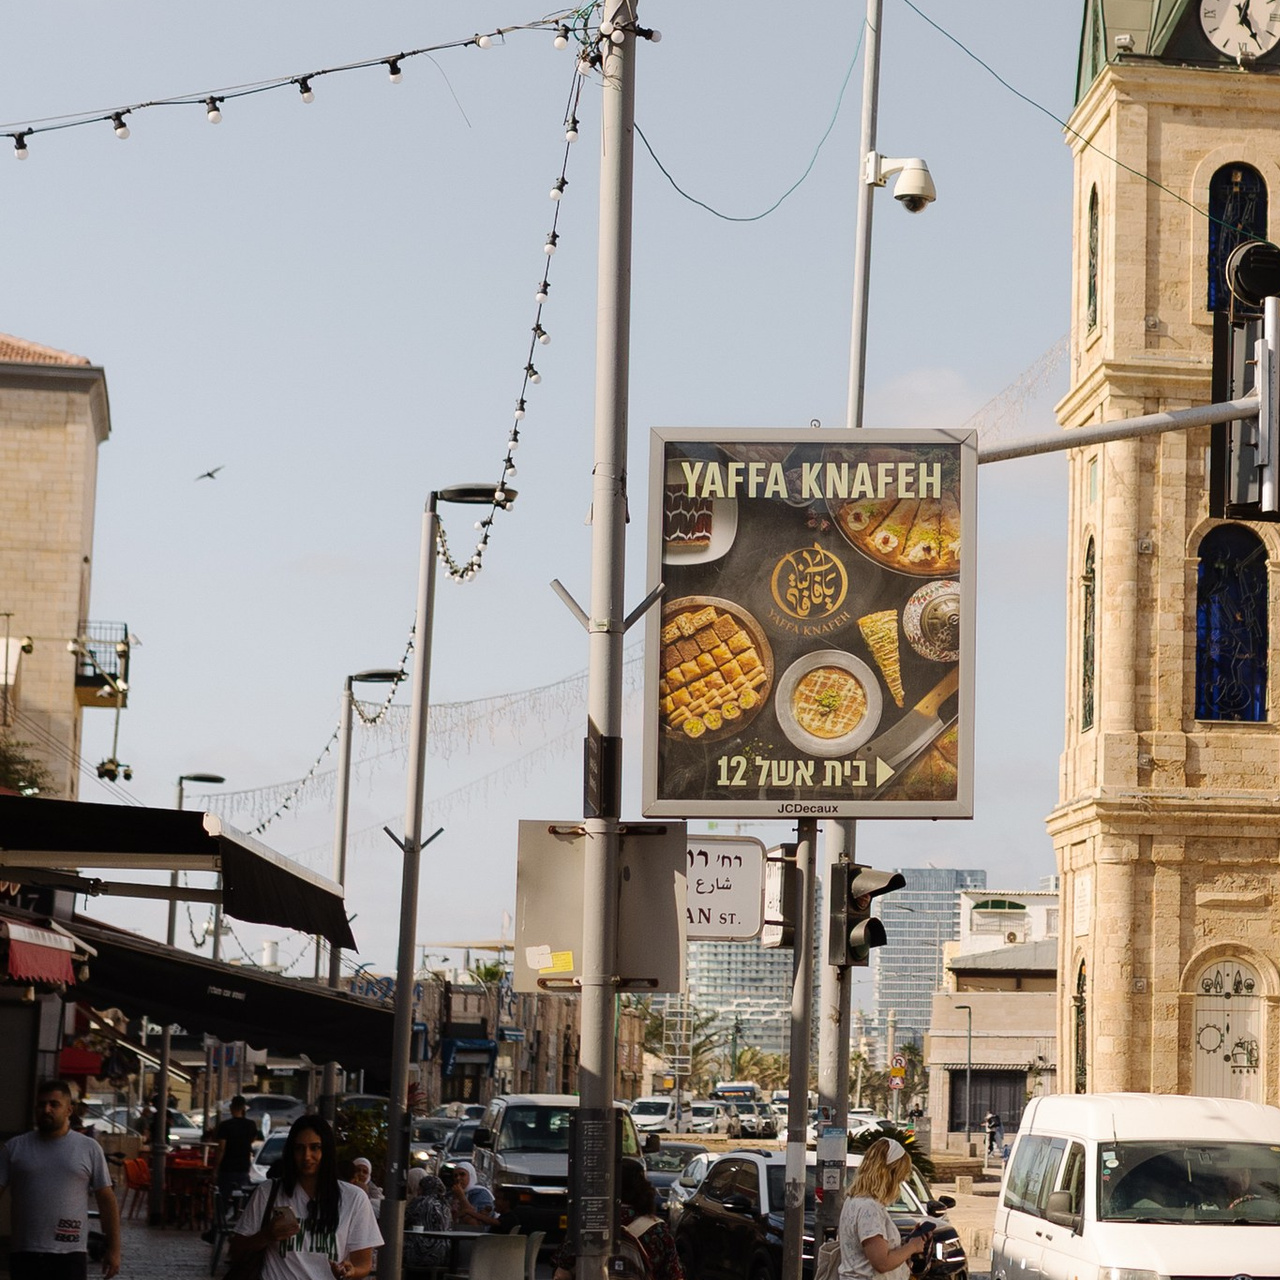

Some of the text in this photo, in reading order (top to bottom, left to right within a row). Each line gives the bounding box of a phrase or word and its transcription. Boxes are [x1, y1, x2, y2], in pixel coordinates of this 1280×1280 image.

[681, 462, 941, 498] YAFFA KNAFEH
[768, 608, 851, 636] YAFFA KNAFEH
[717, 756, 868, 786] בית אשל 12
[778, 803, 839, 814] JCDecaux
[696, 877, 732, 894] شارع
[719, 913, 741, 925] ST.
